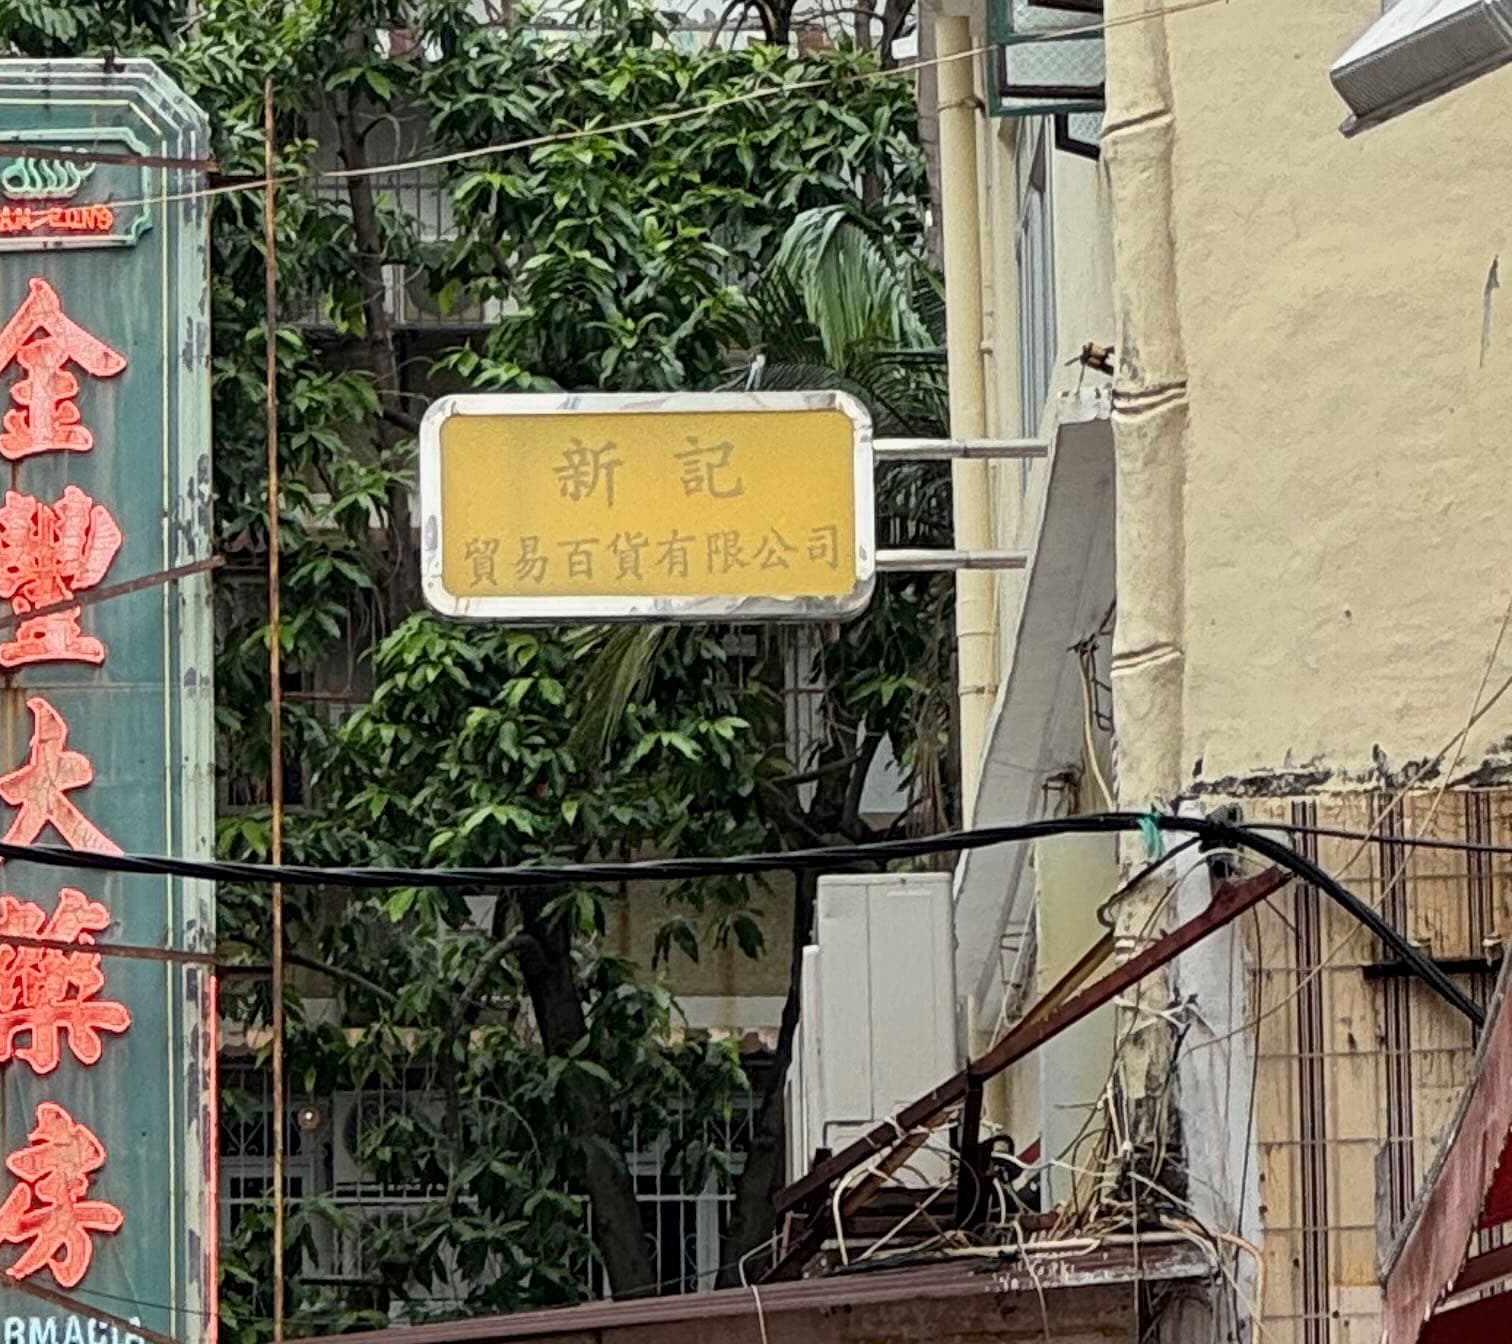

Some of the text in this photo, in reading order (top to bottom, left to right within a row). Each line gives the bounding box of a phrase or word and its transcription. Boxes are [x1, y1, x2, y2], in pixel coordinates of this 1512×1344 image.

[552, 435, 745, 508] 新記
[464, 524, 840, 588] 貿易百貨有限公司
